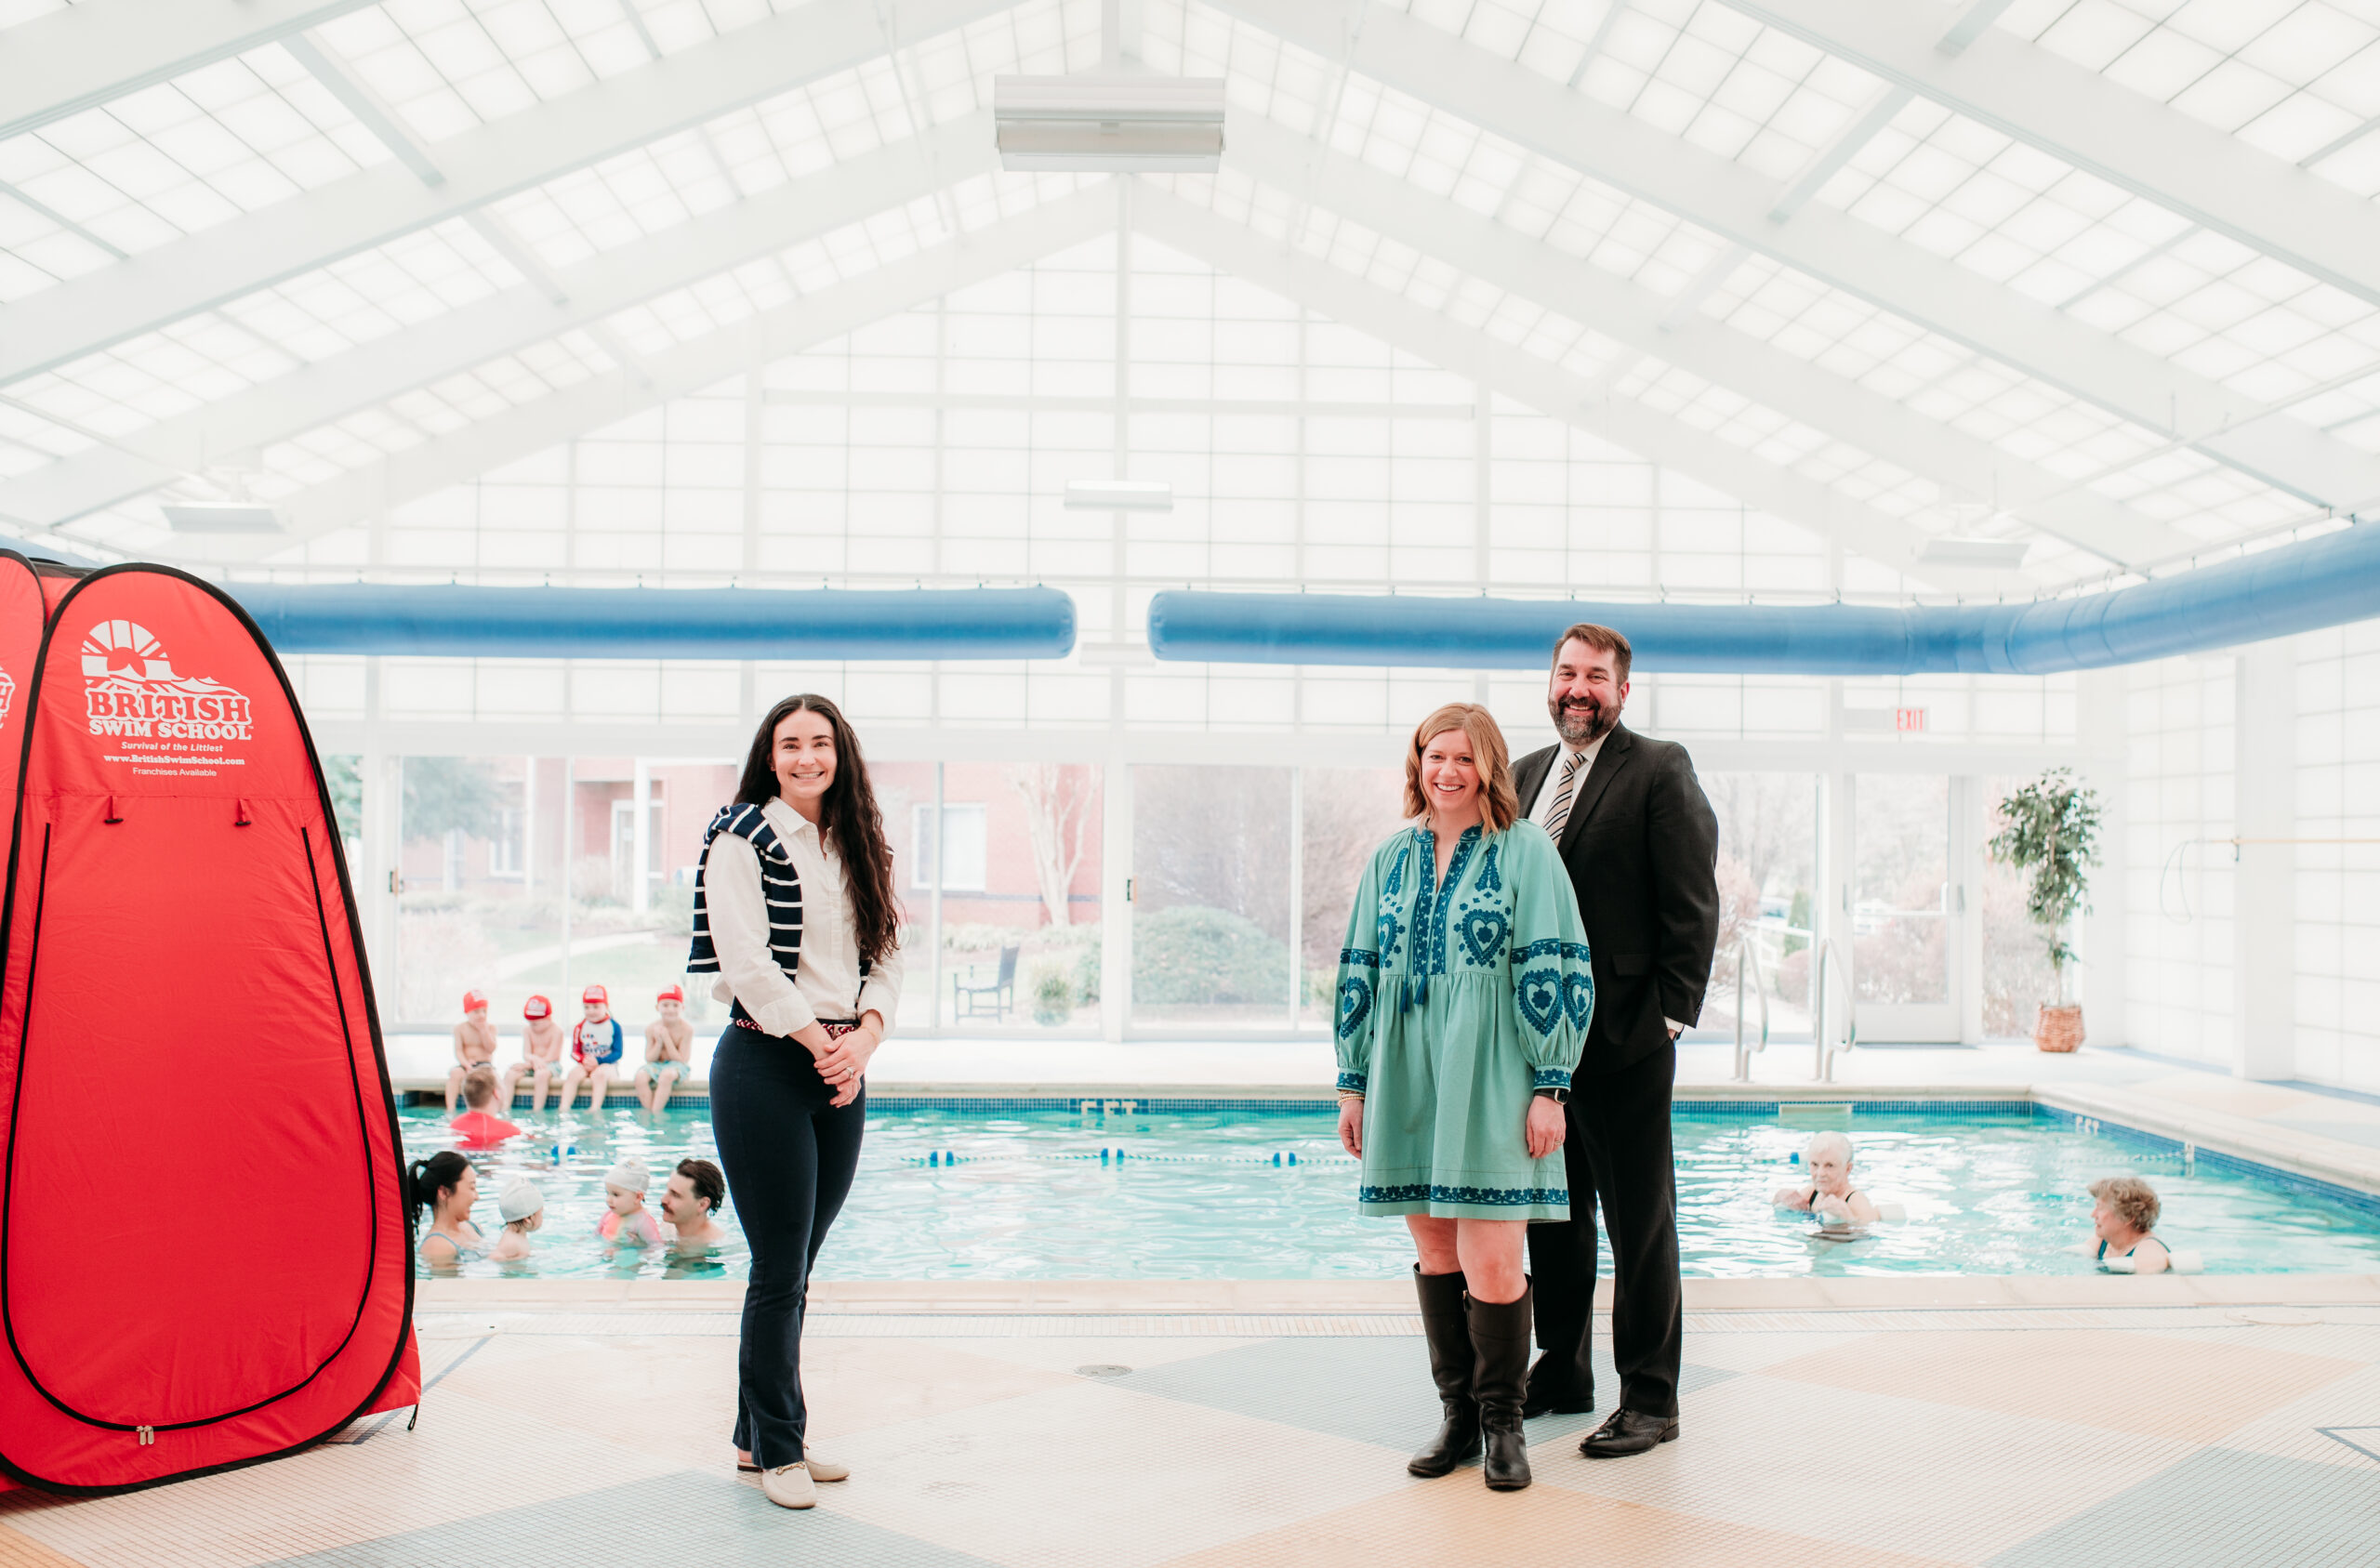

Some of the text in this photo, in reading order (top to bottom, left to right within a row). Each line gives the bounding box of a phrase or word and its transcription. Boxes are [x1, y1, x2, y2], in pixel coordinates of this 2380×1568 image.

[86, 688, 252, 725] BRITISH
[1897, 708, 1924, 731] EXIT
[89, 719, 252, 740] SWIM SCHOOL
[121, 742, 158, 750] Survival
[160, 743, 171, 751] of
[103, 755, 245, 765] www.BritishSwimSchool.com
[132, 767, 217, 777] Franchises Available
